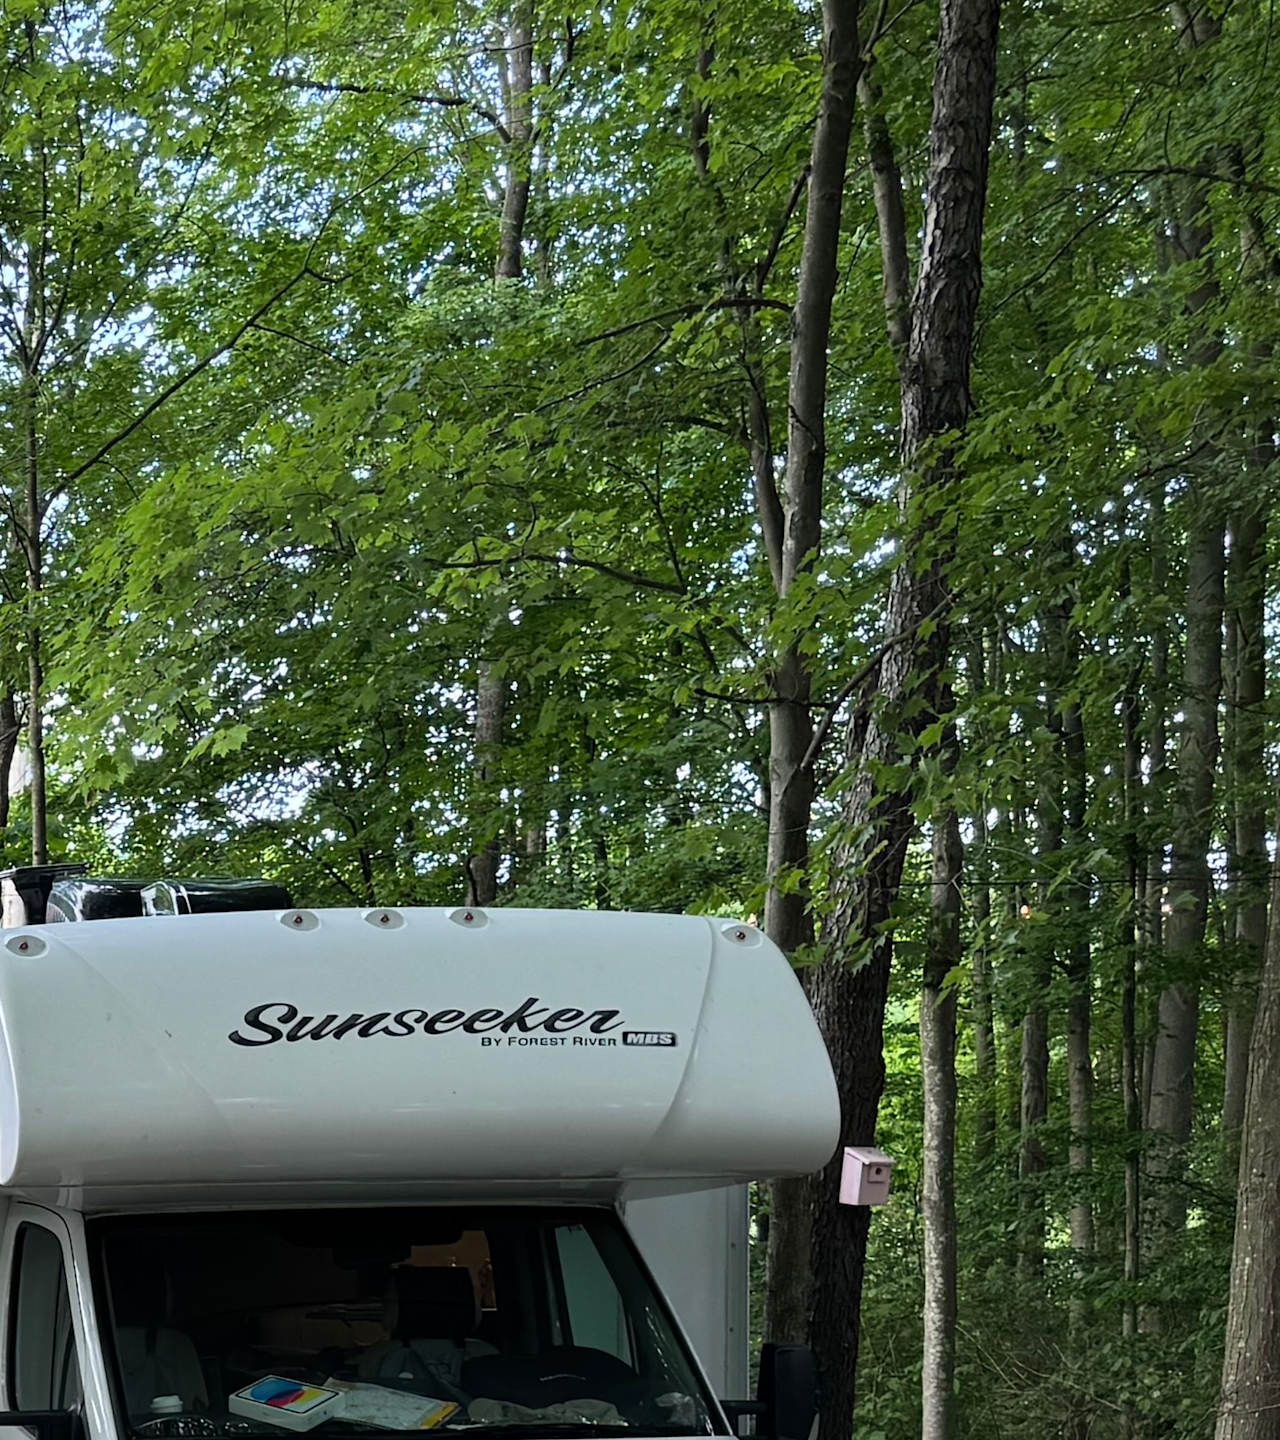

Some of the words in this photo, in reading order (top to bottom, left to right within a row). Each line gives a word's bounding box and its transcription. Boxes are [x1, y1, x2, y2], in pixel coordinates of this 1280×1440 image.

[228, 997, 626, 1047] Sunseeker
[508, 1037, 567, 1047] FOREST
[573, 1037, 617, 1047] RIVER
[625, 1032, 674, 1046] MBS
